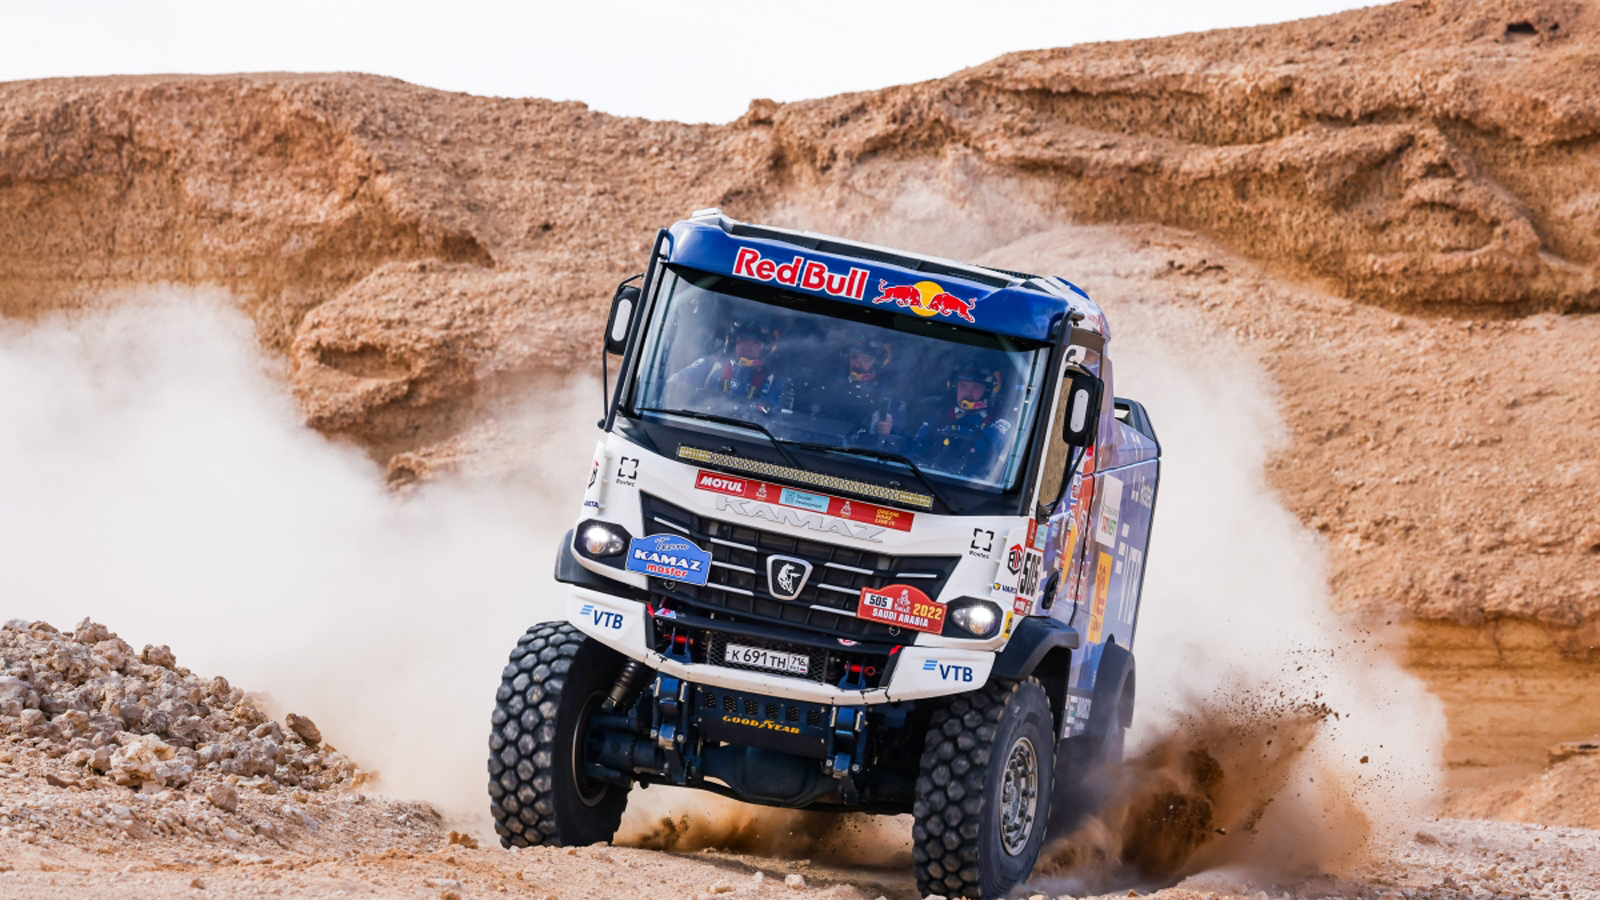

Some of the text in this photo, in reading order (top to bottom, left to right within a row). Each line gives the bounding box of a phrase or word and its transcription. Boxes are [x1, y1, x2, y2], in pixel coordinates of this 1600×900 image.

[732, 246, 870, 301] Red Bull
[700, 475, 742, 493] MOTUL
[716, 495, 886, 544] KAMAZ
[633, 548, 702, 572] KAMAZ
[646, 563, 688, 578] master
[869, 594, 888, 608] 505
[594, 610, 624, 629] VTB
[872, 607, 897, 622] SAUDI
[898, 613, 929, 628] ARABIA
[912, 602, 943, 620] 2022
[791, 655, 806, 667] 716
[939, 664, 973, 682] VTB
[722, 715, 799, 734] GOODYEAR
